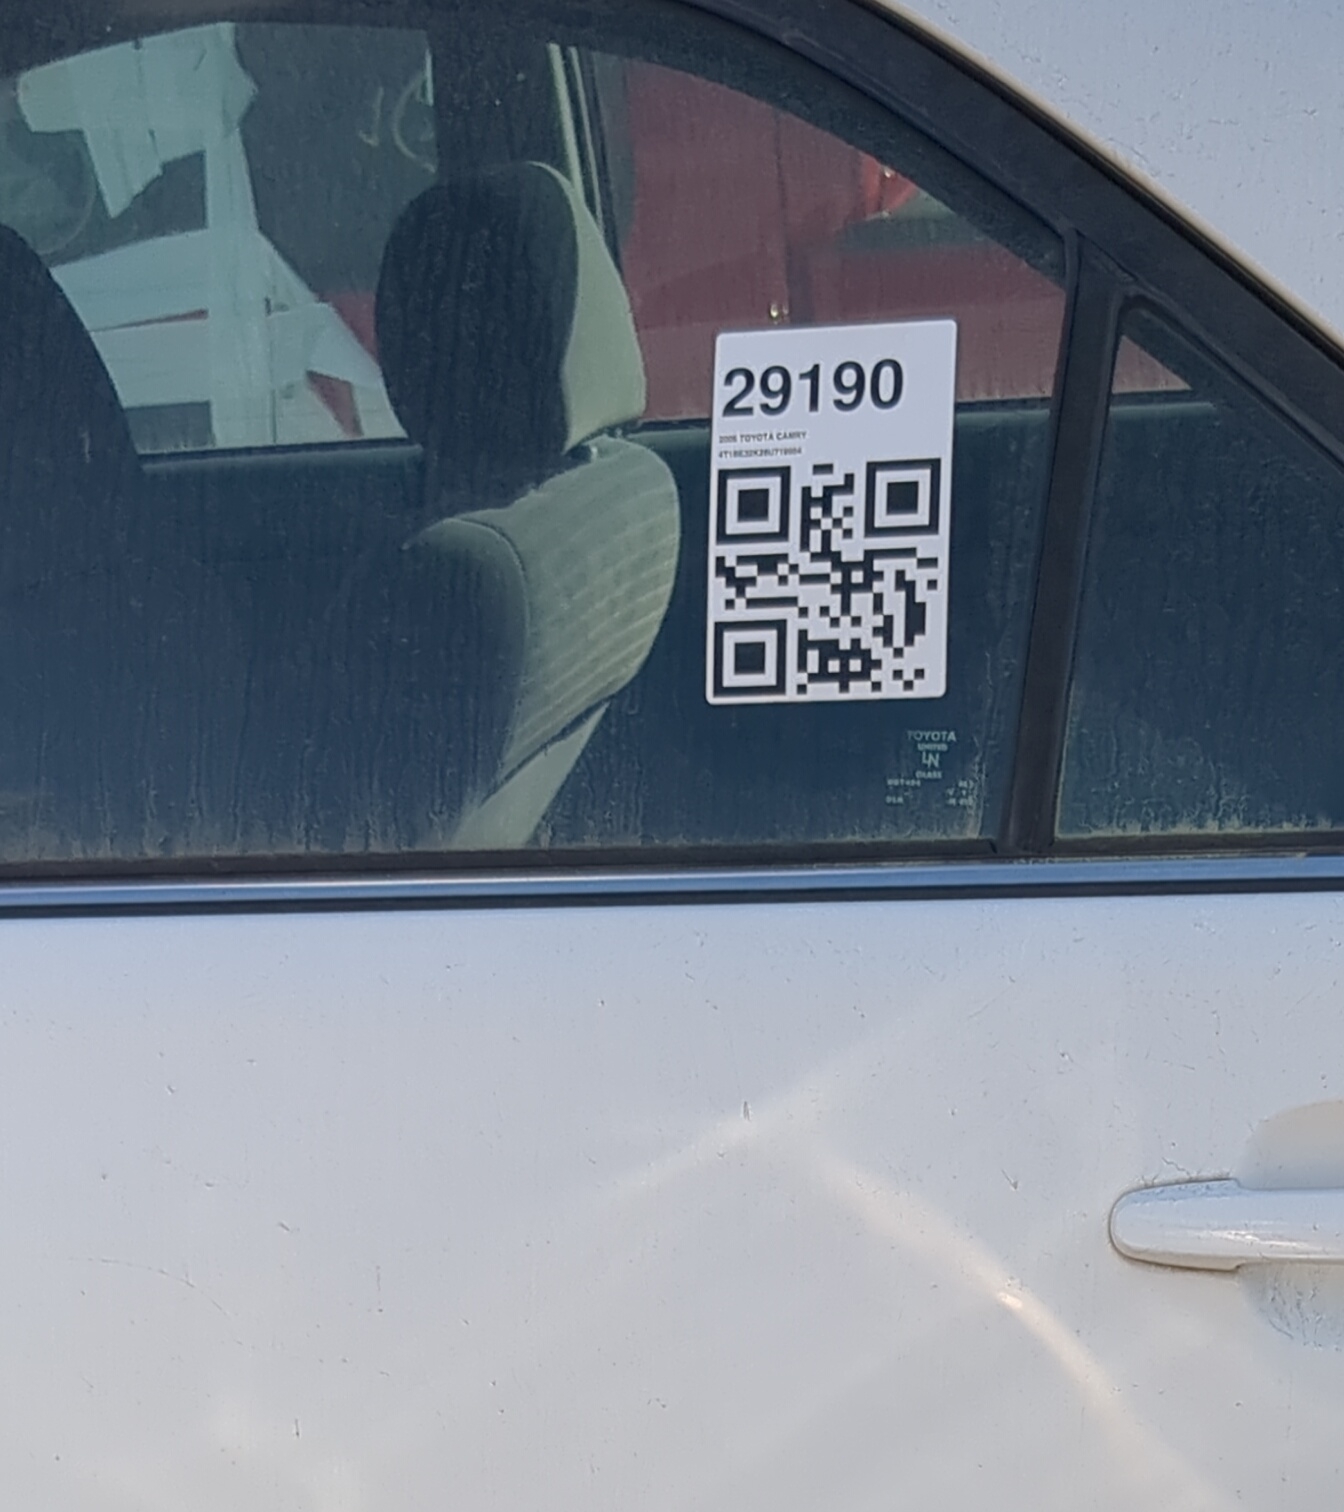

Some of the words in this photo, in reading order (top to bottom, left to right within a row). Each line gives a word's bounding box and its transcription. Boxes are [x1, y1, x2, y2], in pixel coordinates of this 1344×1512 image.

[722, 359, 903, 417] 29190
[740, 433, 774, 443] TOYOTA
[776, 431, 807, 441] CAMRY
[907, 730, 957, 742] TOYOTA
